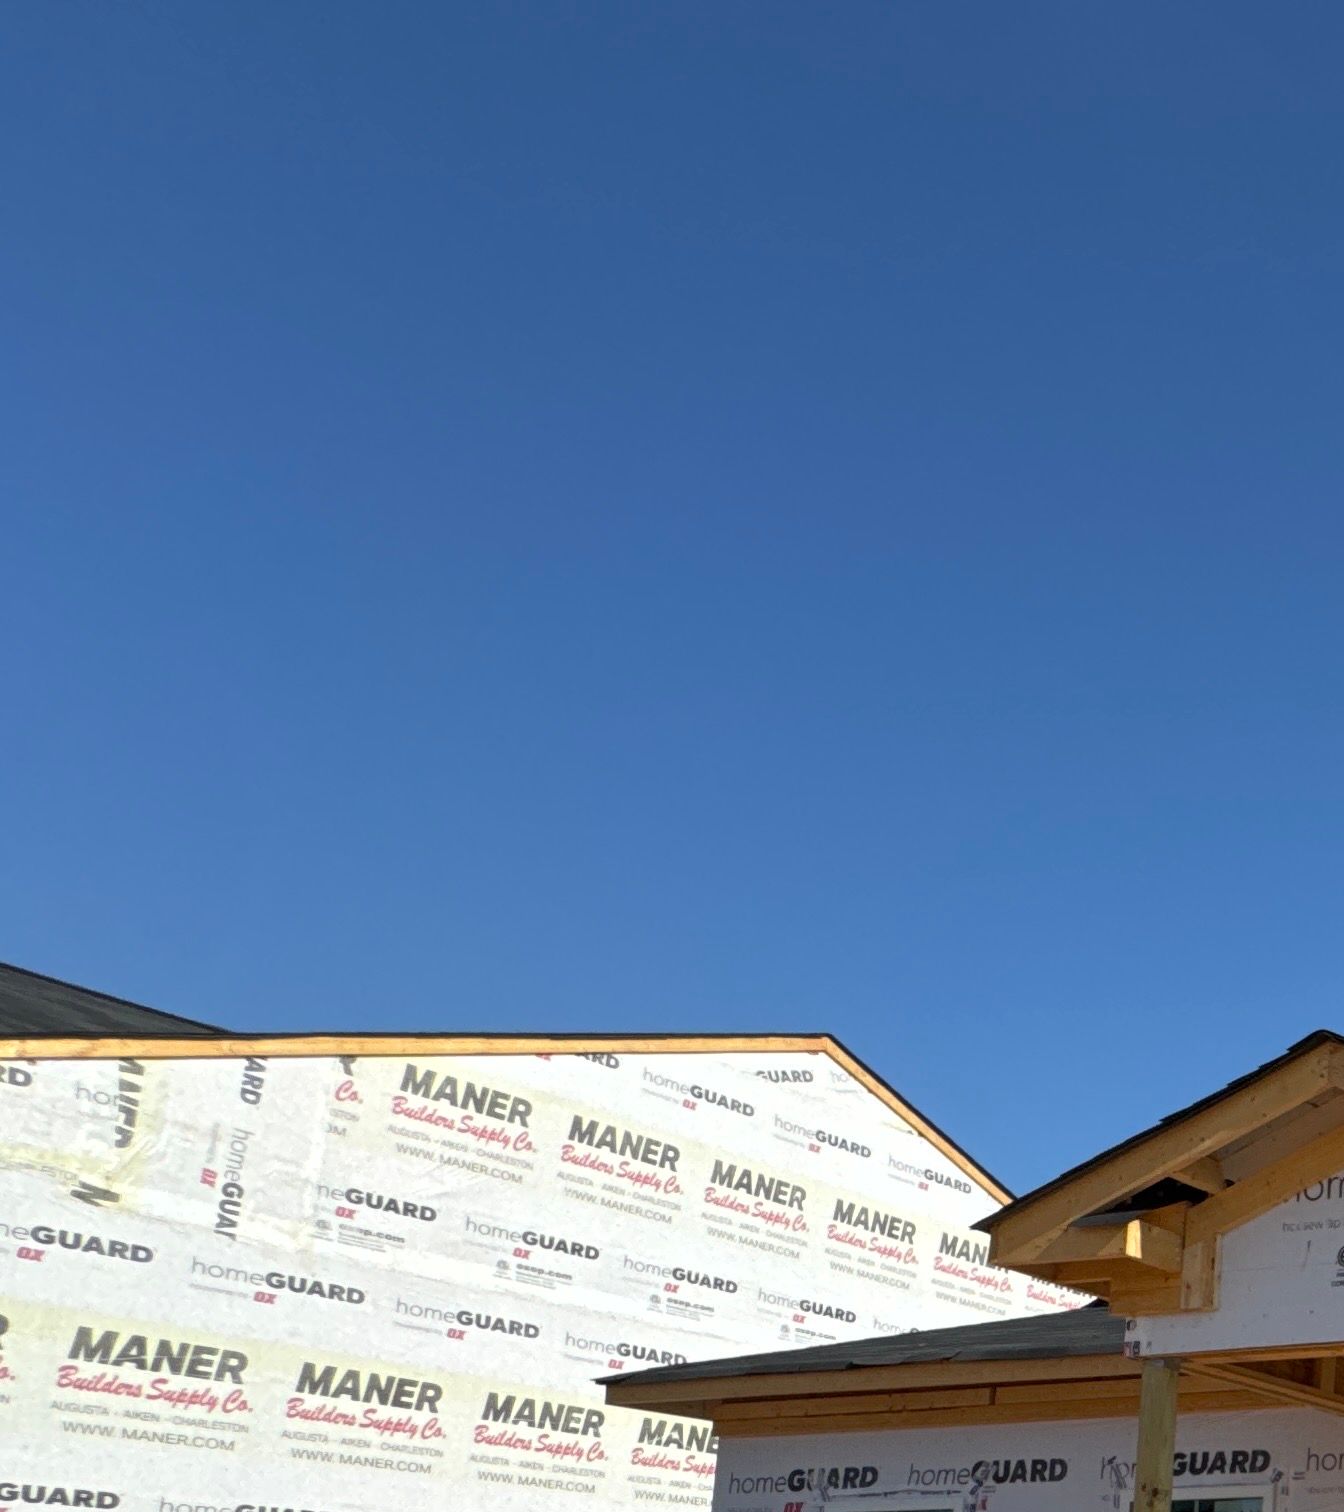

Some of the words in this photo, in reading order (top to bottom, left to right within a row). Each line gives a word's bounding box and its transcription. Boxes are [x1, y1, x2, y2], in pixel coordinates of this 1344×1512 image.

[335, 1079, 364, 1105] Co.
[401, 1063, 534, 1129] MANER
[643, 1067, 755, 1117] homeGUARD
[391, 1095, 455, 1130] Builders
[456, 1115, 512, 1151] Supply
[514, 1132, 538, 1153] Co.
[568, 1114, 681, 1173] MANER
[774, 1114, 872, 1159] homeGUARD
[560, 1144, 614, 1176] Builders
[616, 1160, 662, 1193] Supply
[664, 1175, 685, 1195] Co.
[710, 1159, 807, 1212] MANER
[888, 1154, 972, 1194] homeGUARD
[704, 1186, 750, 1217] Builders
[750, 1201, 791, 1232] Supply
[833, 1198, 917, 1246] MANER
[466, 1215, 601, 1261] homeGUARD
[191, 1255, 366, 1305] homeGUARD
[623, 1254, 739, 1294] homeGUARD
[253, 1291, 278, 1305] OX
[396, 1299, 541, 1339] homeGUARD
[758, 1286, 857, 1324] homeGUARD
[68, 1325, 249, 1385] MANER
[446, 1328, 468, 1342] OX
[56, 1364, 144, 1399] Builders
[146, 1378, 218, 1414] Supply
[222, 1388, 254, 1414] Co.
[295, 1361, 444, 1414] MANER
[286, 1396, 357, 1428] Builders
[359, 1408, 420, 1440] Supply
[420, 1417, 447, 1440] Co.
[481, 1391, 606, 1439] MANER
[121, 1426, 236, 1452] MANER.COM
[473, 1424, 533, 1452] Builders
[534, 1433, 585, 1461] Supply
[586, 1441, 609, 1463] Co.
[630, 1447, 682, 1471] Builders
[339, 1454, 433, 1475] MANER.COM
[517, 1475, 596, 1495] MANER.COM
